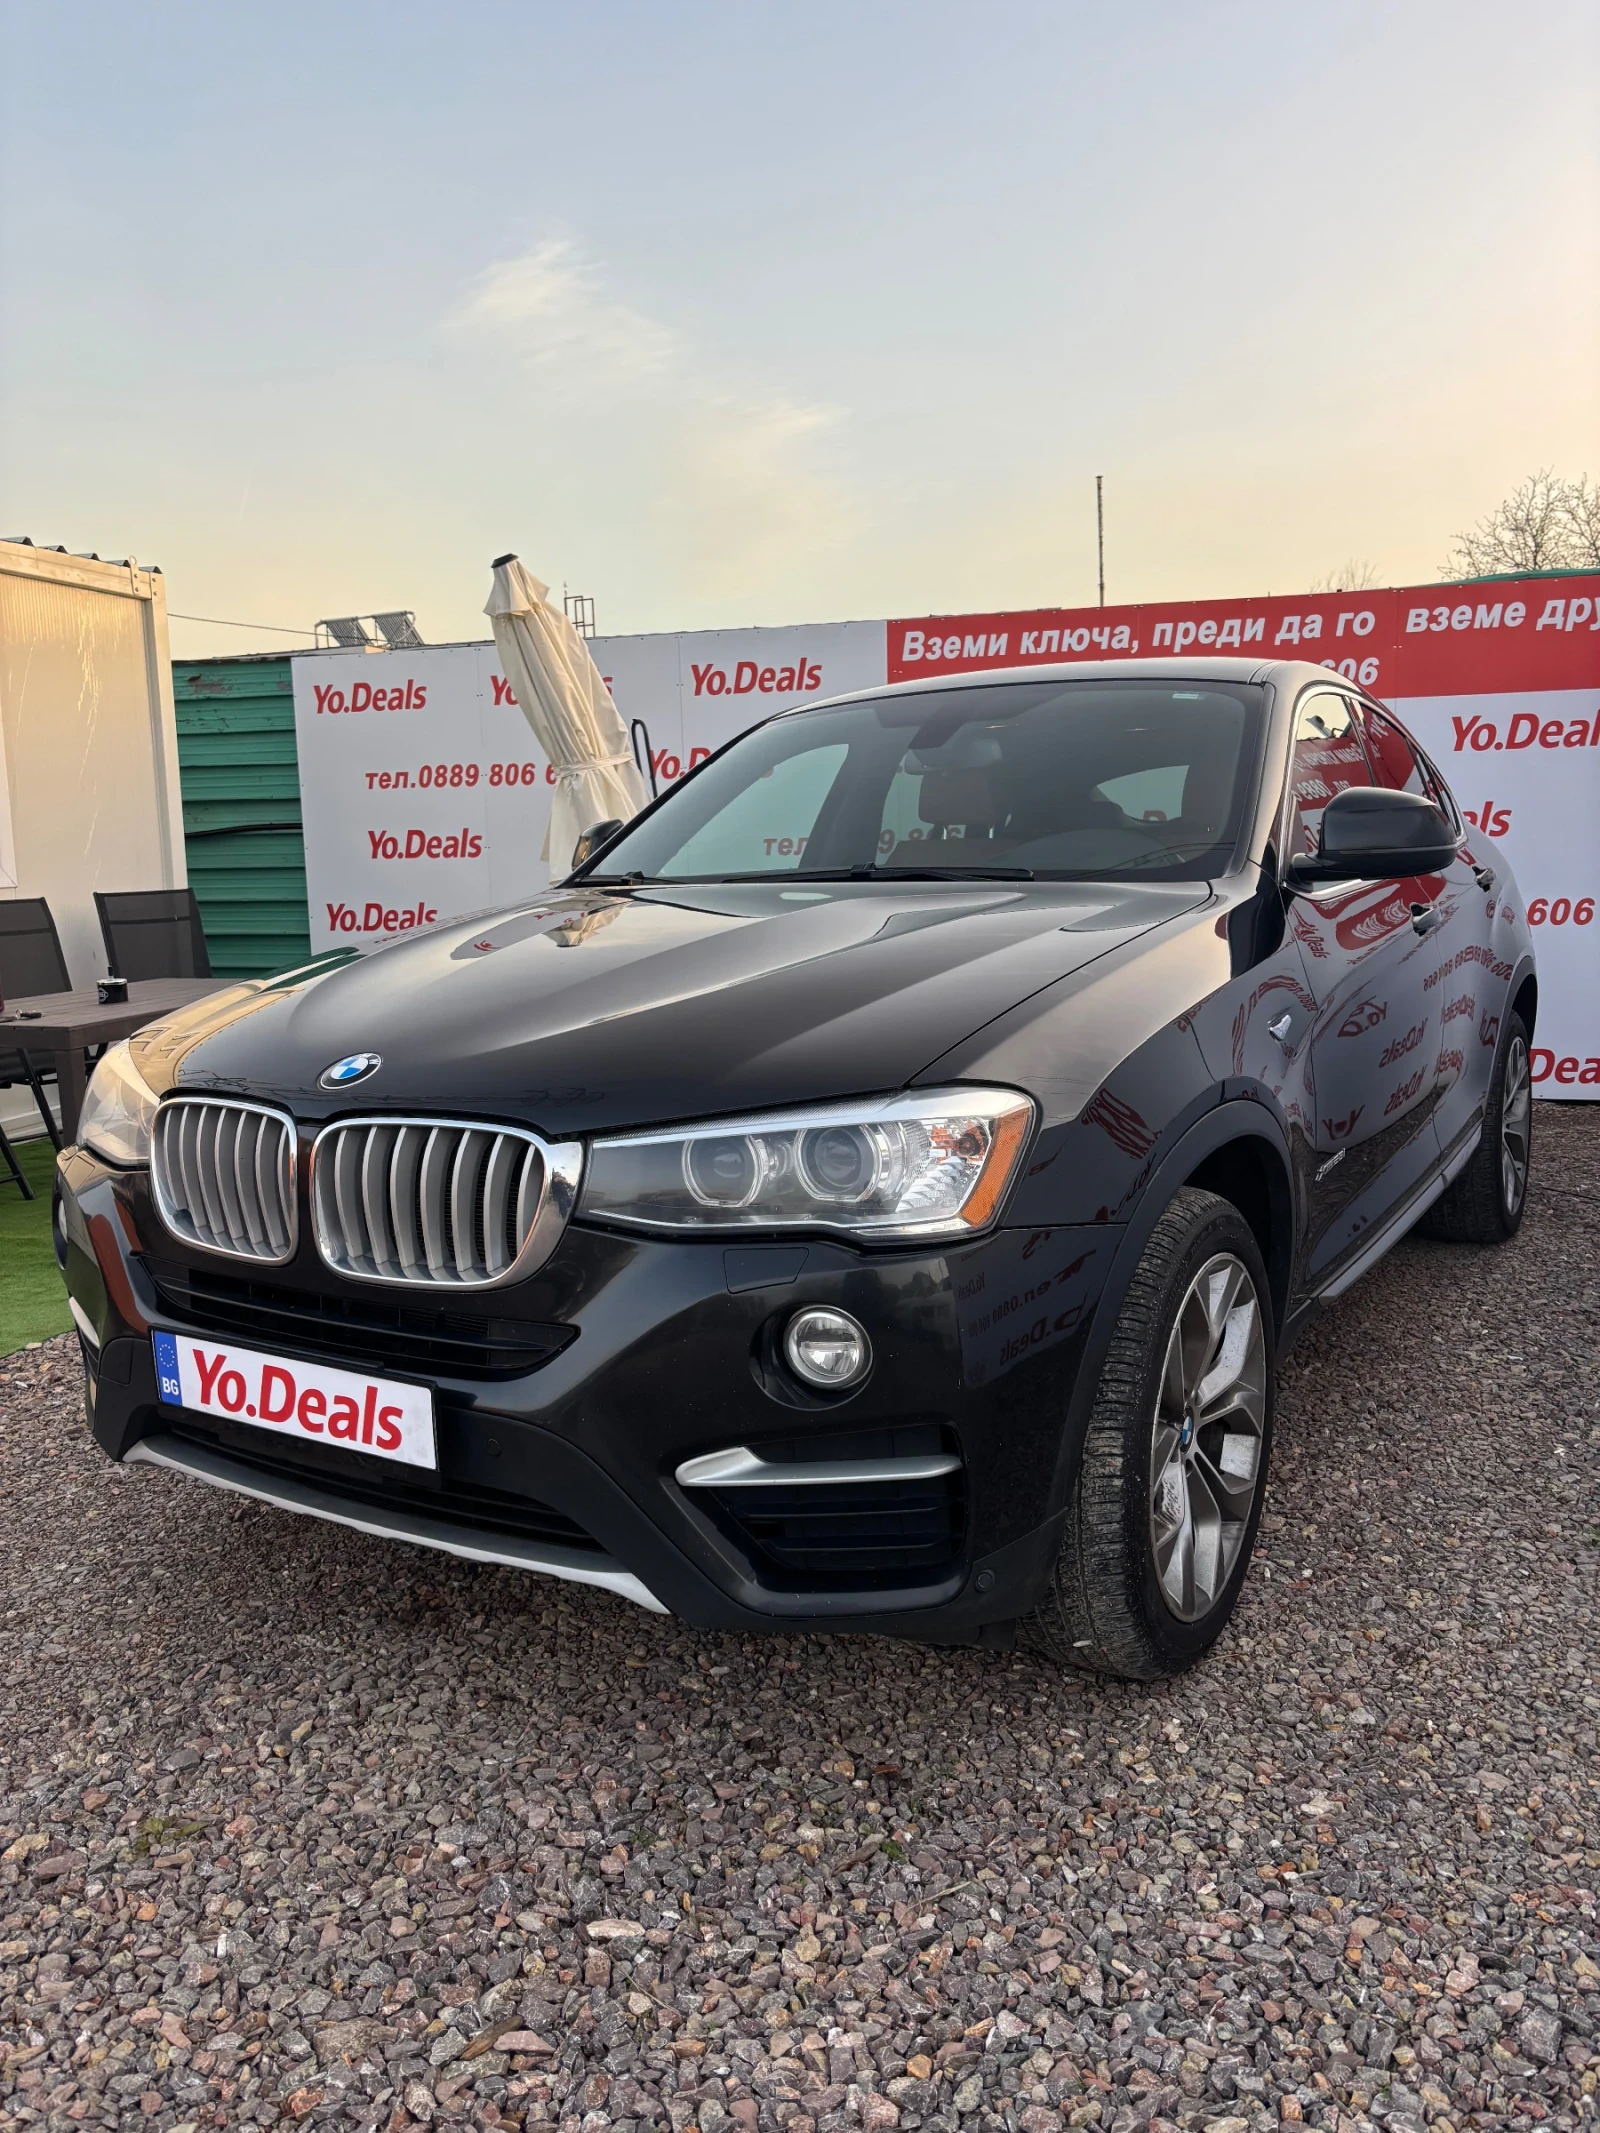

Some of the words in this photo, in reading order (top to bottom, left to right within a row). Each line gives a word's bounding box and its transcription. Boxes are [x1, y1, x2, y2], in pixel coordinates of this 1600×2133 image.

[902, 631, 1008, 662] Вземи
[1019, 624, 1139, 654] ключа,
[1152, 617, 1266, 653] преди
[1274, 613, 1324, 646] да
[1335, 610, 1376, 637] го
[1405, 601, 1526, 633] вземе
[691, 658, 823, 697] Yo.Deals
[313, 678, 427, 715] Yo.Deals
[365, 764, 480, 790] тел.0889
[489, 763, 537, 787] 806
[367, 828, 483, 860] Yo.Deals
[326, 902, 438, 932] Yo.Deals
[1527, 898, 1596, 926] 606
[162, 1376, 179, 1397] BG
[192, 1348, 404, 1451] Yo.Deals
